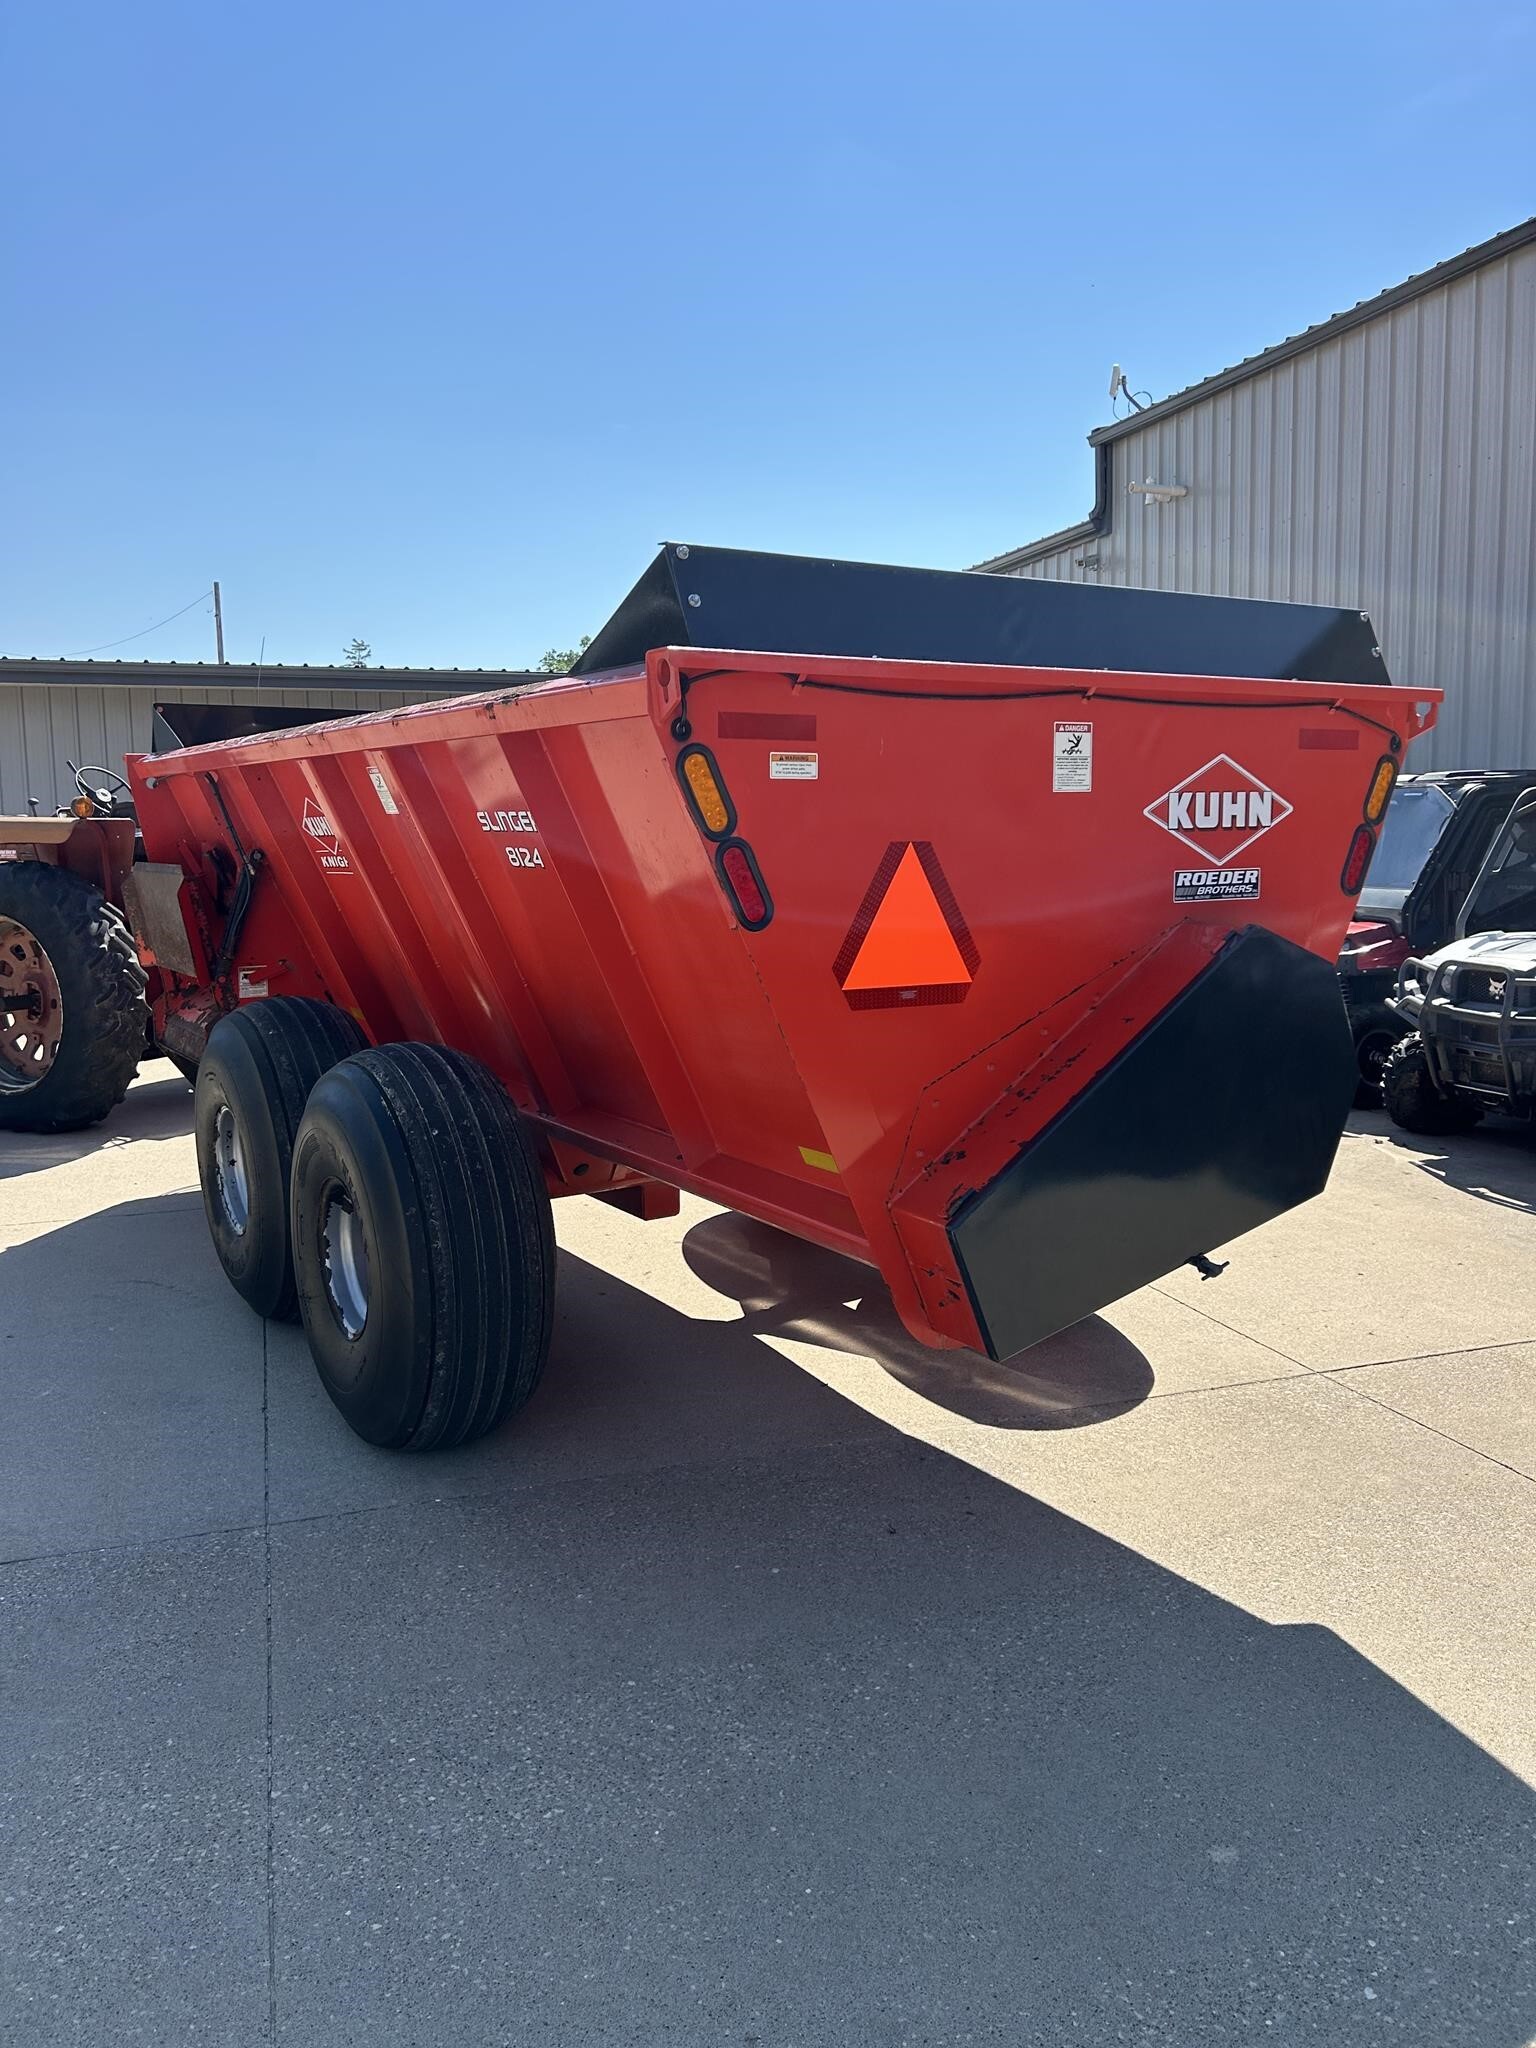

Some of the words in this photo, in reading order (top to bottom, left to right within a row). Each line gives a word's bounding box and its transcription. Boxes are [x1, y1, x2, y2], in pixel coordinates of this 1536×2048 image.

[1168, 791, 1272, 829] KUHN
[505, 846, 545, 868] 8124
[1176, 870, 1259, 887] ROEDER
[1196, 885, 1253, 895] BROTHERS
